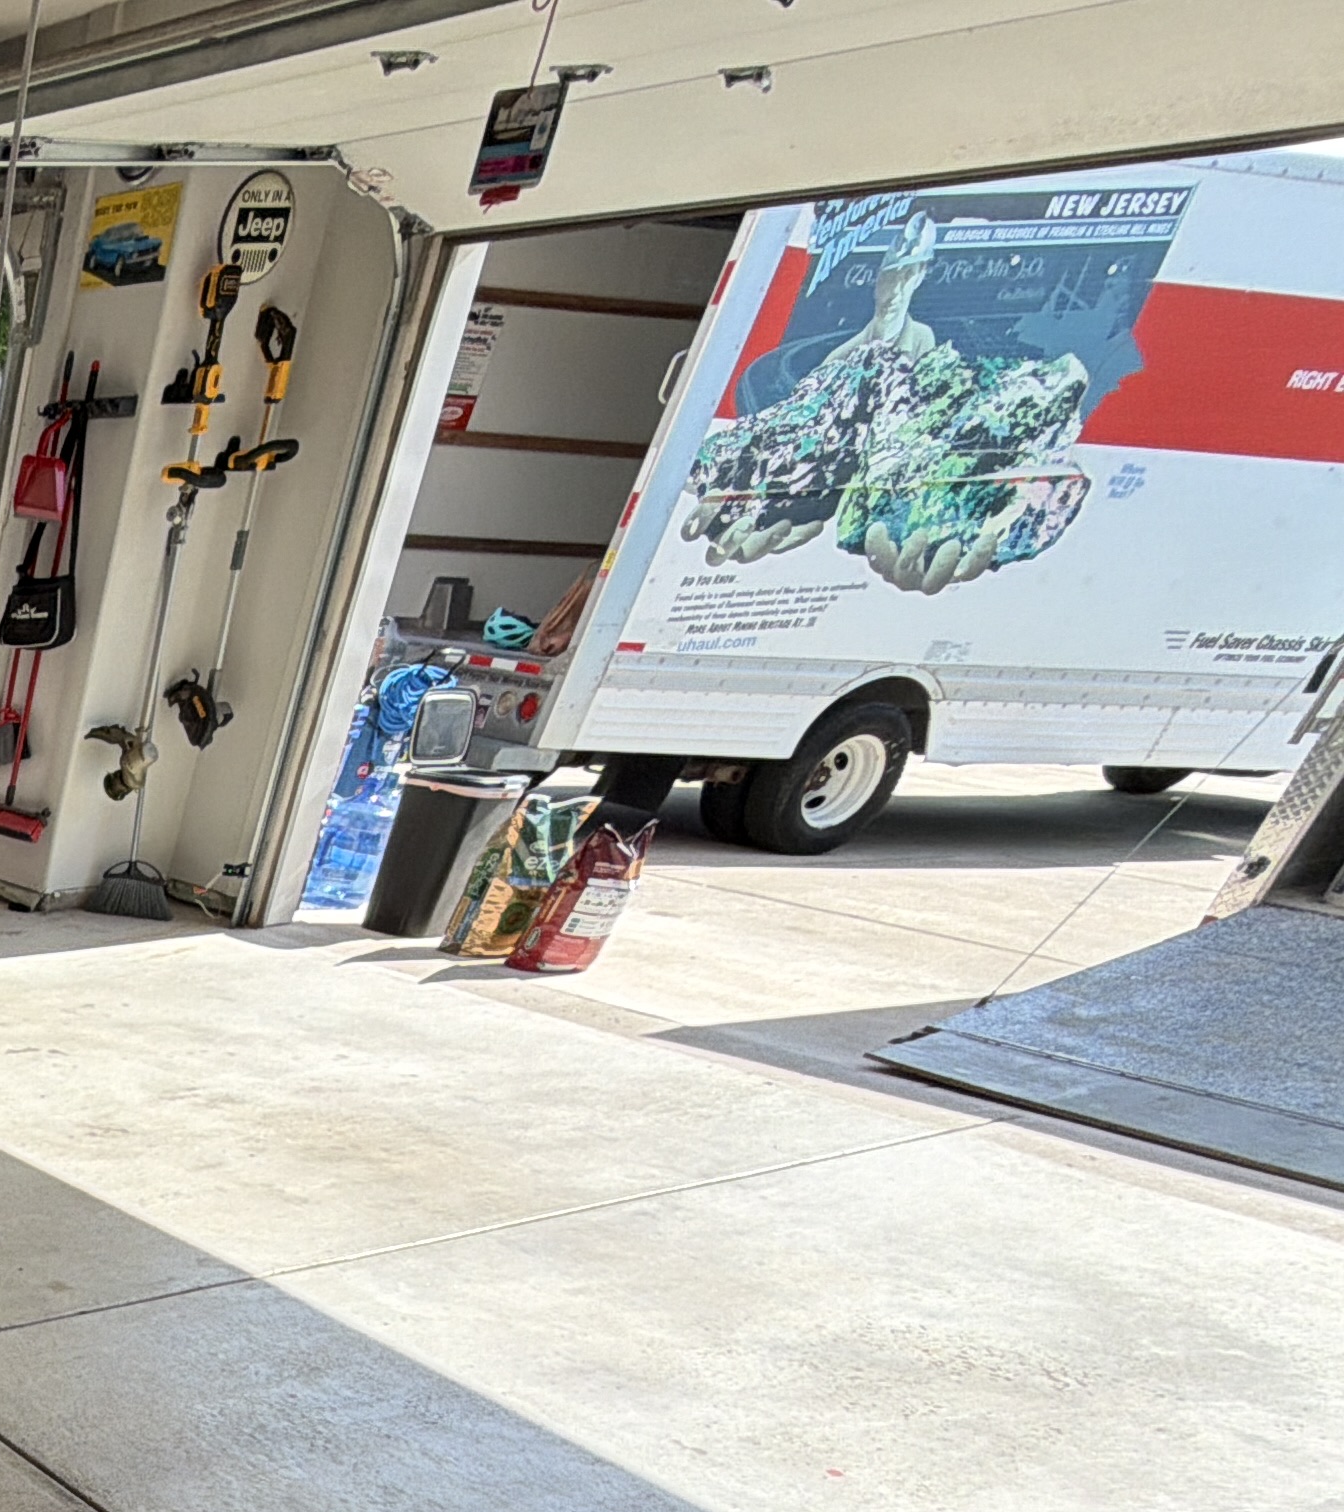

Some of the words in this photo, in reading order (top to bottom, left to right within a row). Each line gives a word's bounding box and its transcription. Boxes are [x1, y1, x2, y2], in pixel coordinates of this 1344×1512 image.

[242, 190, 271, 203] ONLY
[271, 190, 283, 202] IN
[284, 190, 292, 201] A
[1045, 194, 1100, 218] NEW
[1100, 190, 1189, 217] JERSEY
[238, 210, 286, 241] Jeep
[806, 197, 916, 298] America
[1286, 369, 1339, 391] RIGHT
[677, 635, 758, 652] uhaul.com
[1189, 632, 1223, 649] Fuel
[1218, 632, 1259, 650] Saver
[1256, 634, 1306, 651] Chassis
